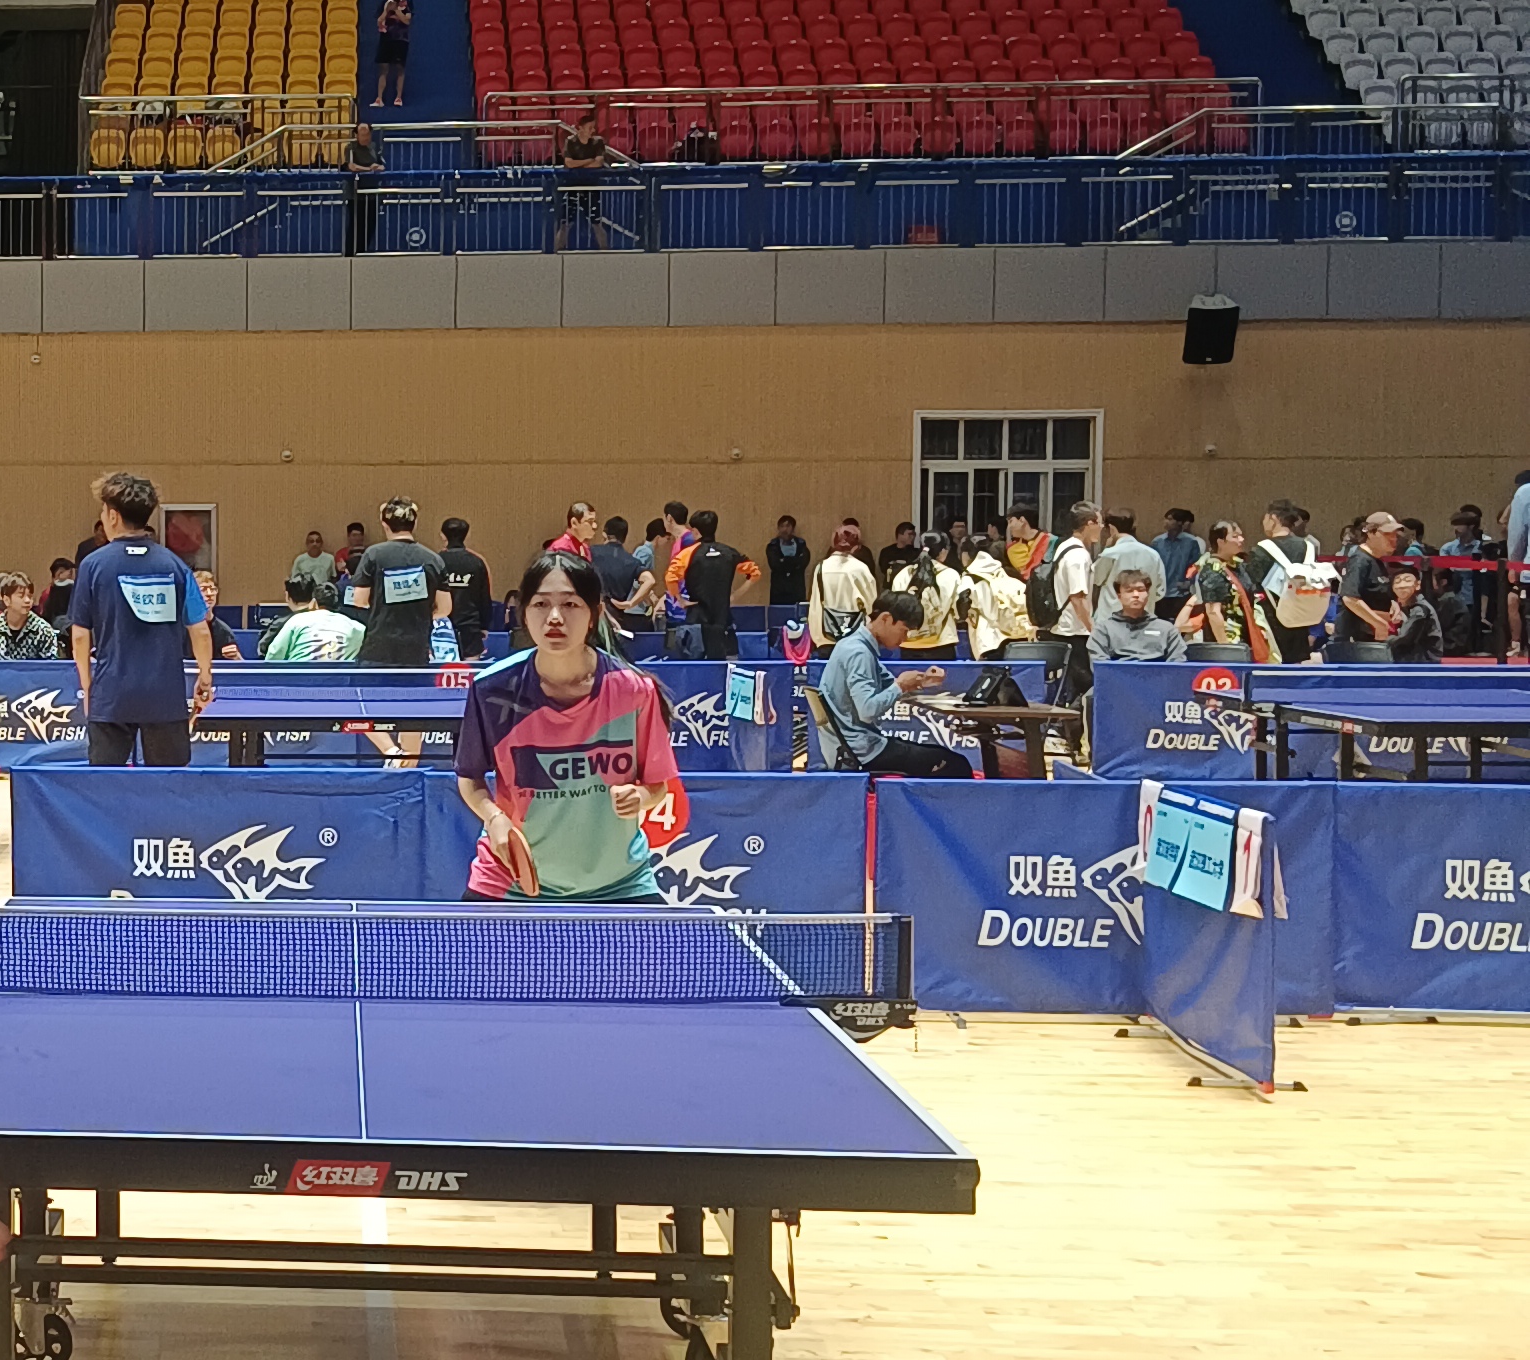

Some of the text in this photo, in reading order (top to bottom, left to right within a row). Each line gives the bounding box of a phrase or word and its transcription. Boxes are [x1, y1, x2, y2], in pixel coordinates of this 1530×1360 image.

[52, 726, 86, 741] FISH
[1146, 728, 1221, 751] DOUBLE
[548, 752, 632, 781] GEWO
[977, 909, 1115, 948] DOUBLE
[1410, 912, 1530, 953] DOUBL
[296, 1166, 379, 1191] 红双喜
[395, 1170, 468, 1191] DHS
